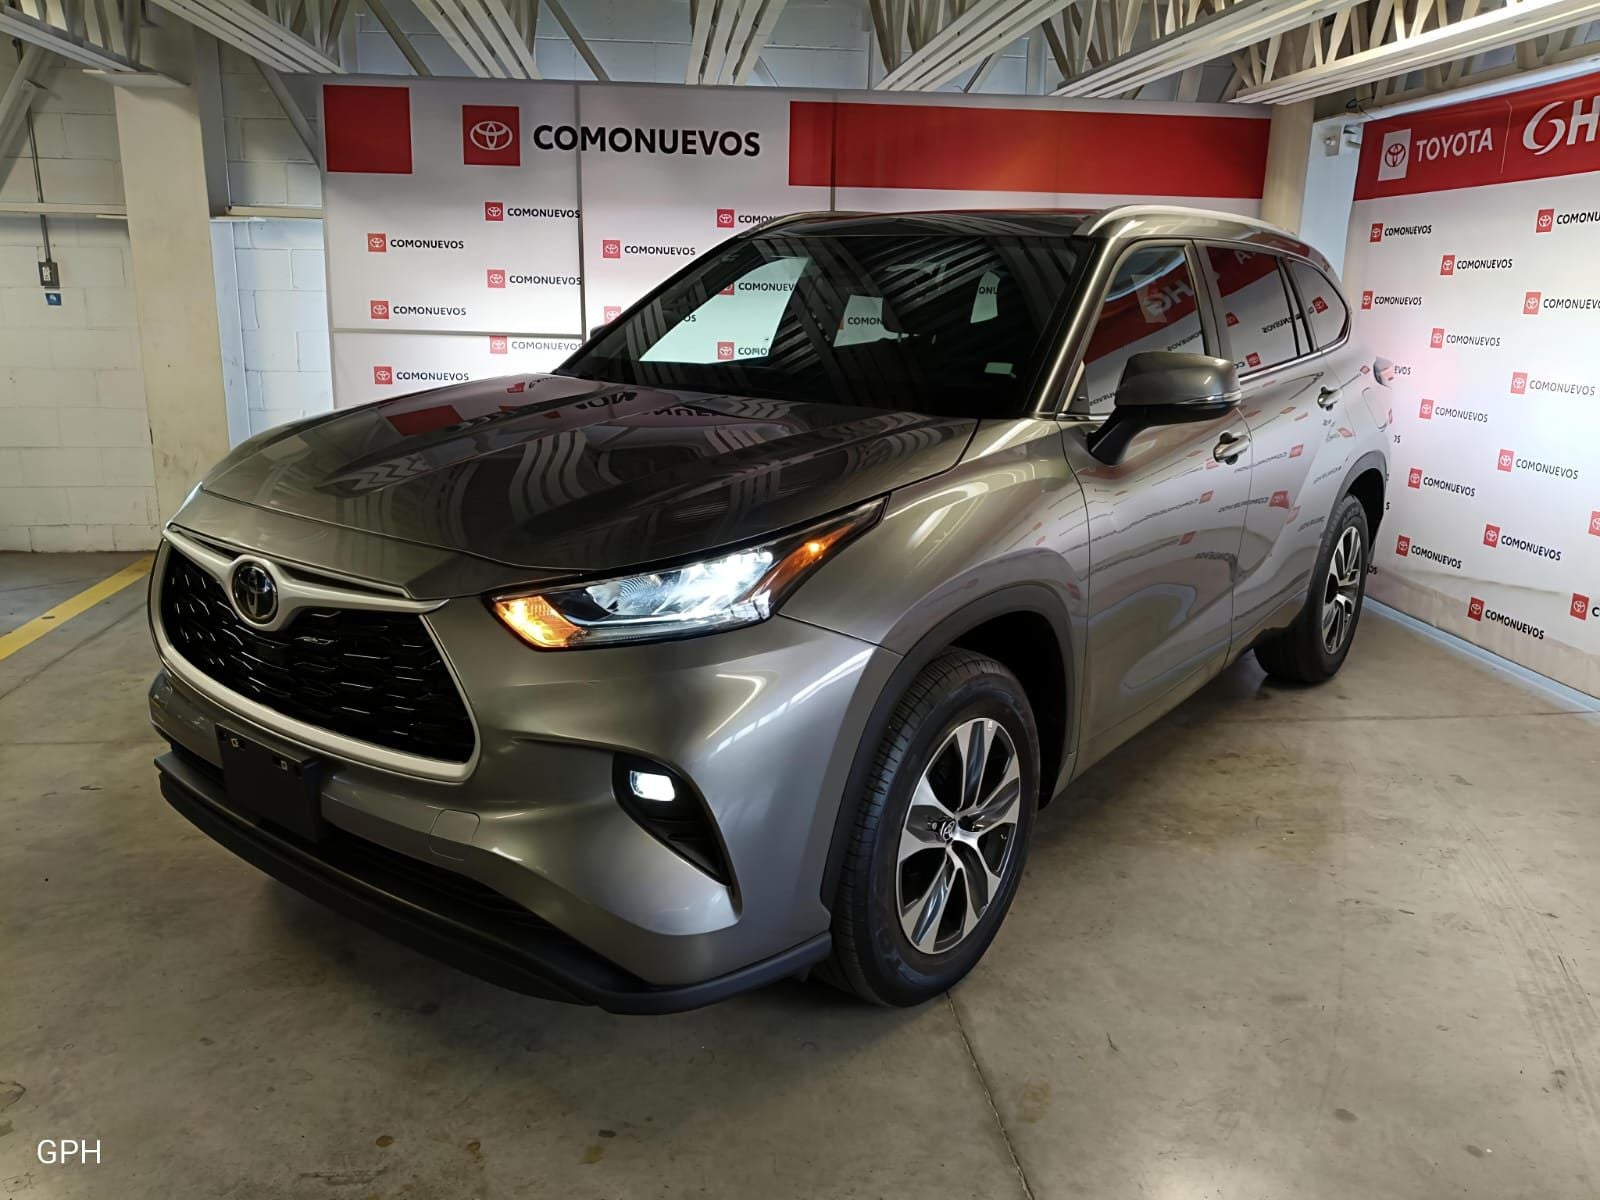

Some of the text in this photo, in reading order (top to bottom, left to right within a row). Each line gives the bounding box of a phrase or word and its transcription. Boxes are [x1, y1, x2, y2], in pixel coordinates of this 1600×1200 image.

[533, 125, 761, 157] COMONUEVOS
[1416, 127, 1494, 163] TOYOTA
[507, 207, 581, 219] COMONUEVOS
[1384, 224, 1432, 237] COMONUEVOS
[390, 239, 464, 250] COMONUEVOS
[624, 245, 696, 256] COMONUEVOS
[1456, 258, 1513, 270] COMONUEVOS
[509, 275, 582, 286] COMONUEVOS
[1374, 296, 1422, 306] COMONUEVOS
[393, 306, 467, 316] COMONUEVOS
[1446, 334, 1501, 347] COMONUEVOS
[396, 371, 470, 381] COMONUEVOS
[1529, 379, 1595, 397] COMONUEVOS
[1435, 406, 1489, 423] COMONUEVOS
[1515, 458, 1579, 480] COMONUEVOS
[1423, 476, 1476, 497] COMONUEVOS
[1500, 534, 1562, 561] COMONUEVOS
[1410, 544, 1463, 569] COMONUEVOS
[1485, 609, 1545, 640] COMONUEVOS
